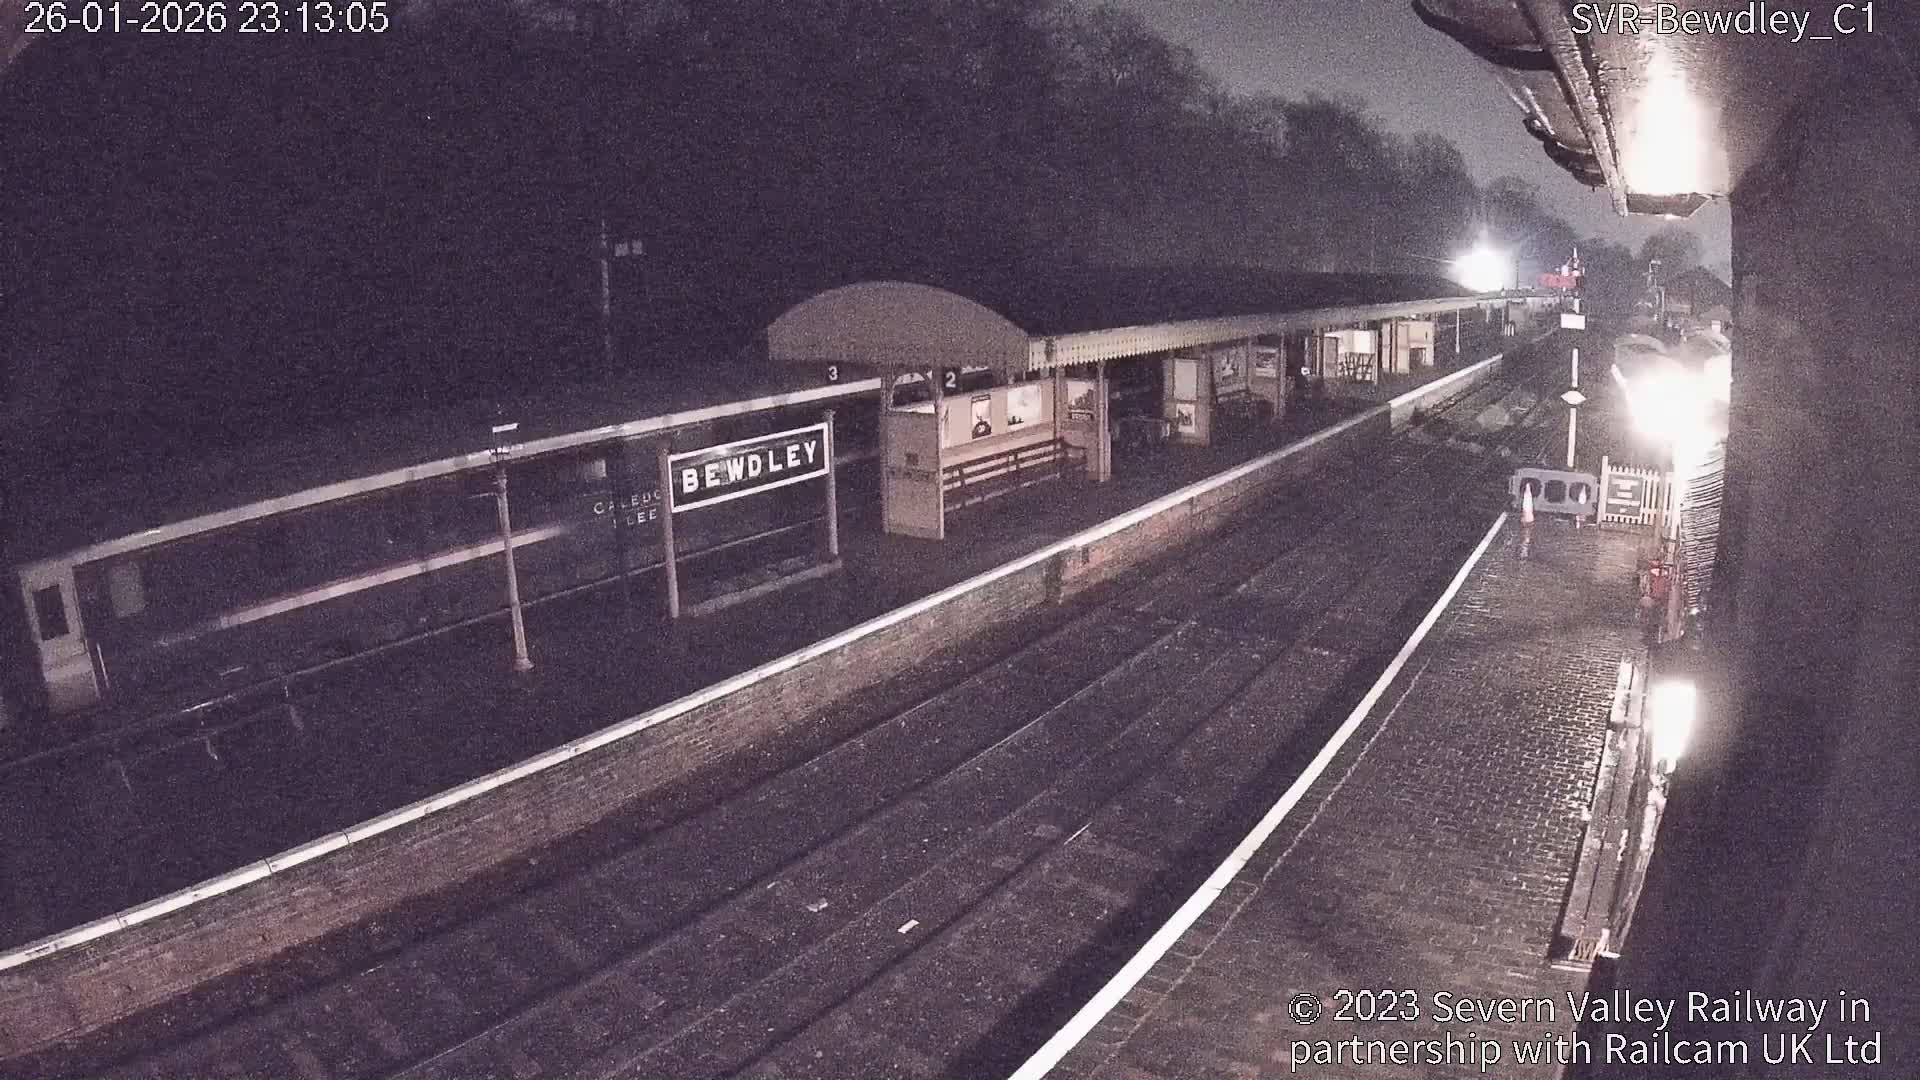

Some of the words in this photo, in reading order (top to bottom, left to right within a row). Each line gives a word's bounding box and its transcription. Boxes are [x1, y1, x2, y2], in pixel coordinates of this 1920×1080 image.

[828, 365, 838, 381] 3
[945, 371, 957, 388] 2
[681, 439, 818, 494] BEWDLEY
